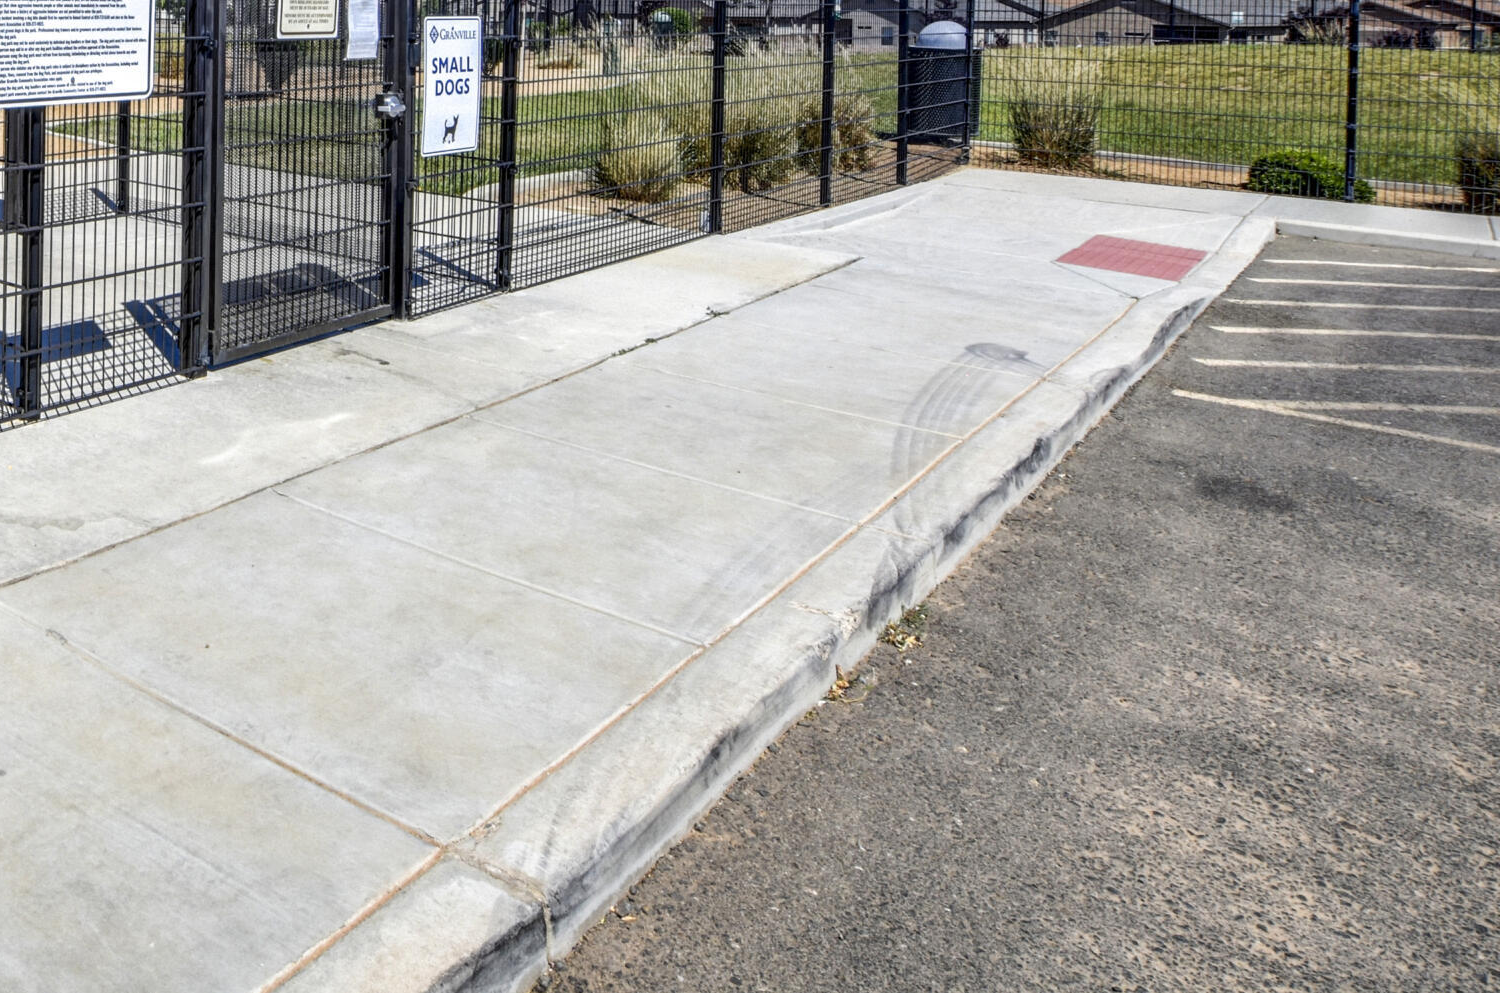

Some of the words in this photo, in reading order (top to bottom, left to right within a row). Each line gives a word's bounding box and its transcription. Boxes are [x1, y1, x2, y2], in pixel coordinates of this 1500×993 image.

[440, 29, 476, 40] GRANVILLE
[432, 56, 474, 74] SMALL
[435, 78, 470, 96] DOGS
